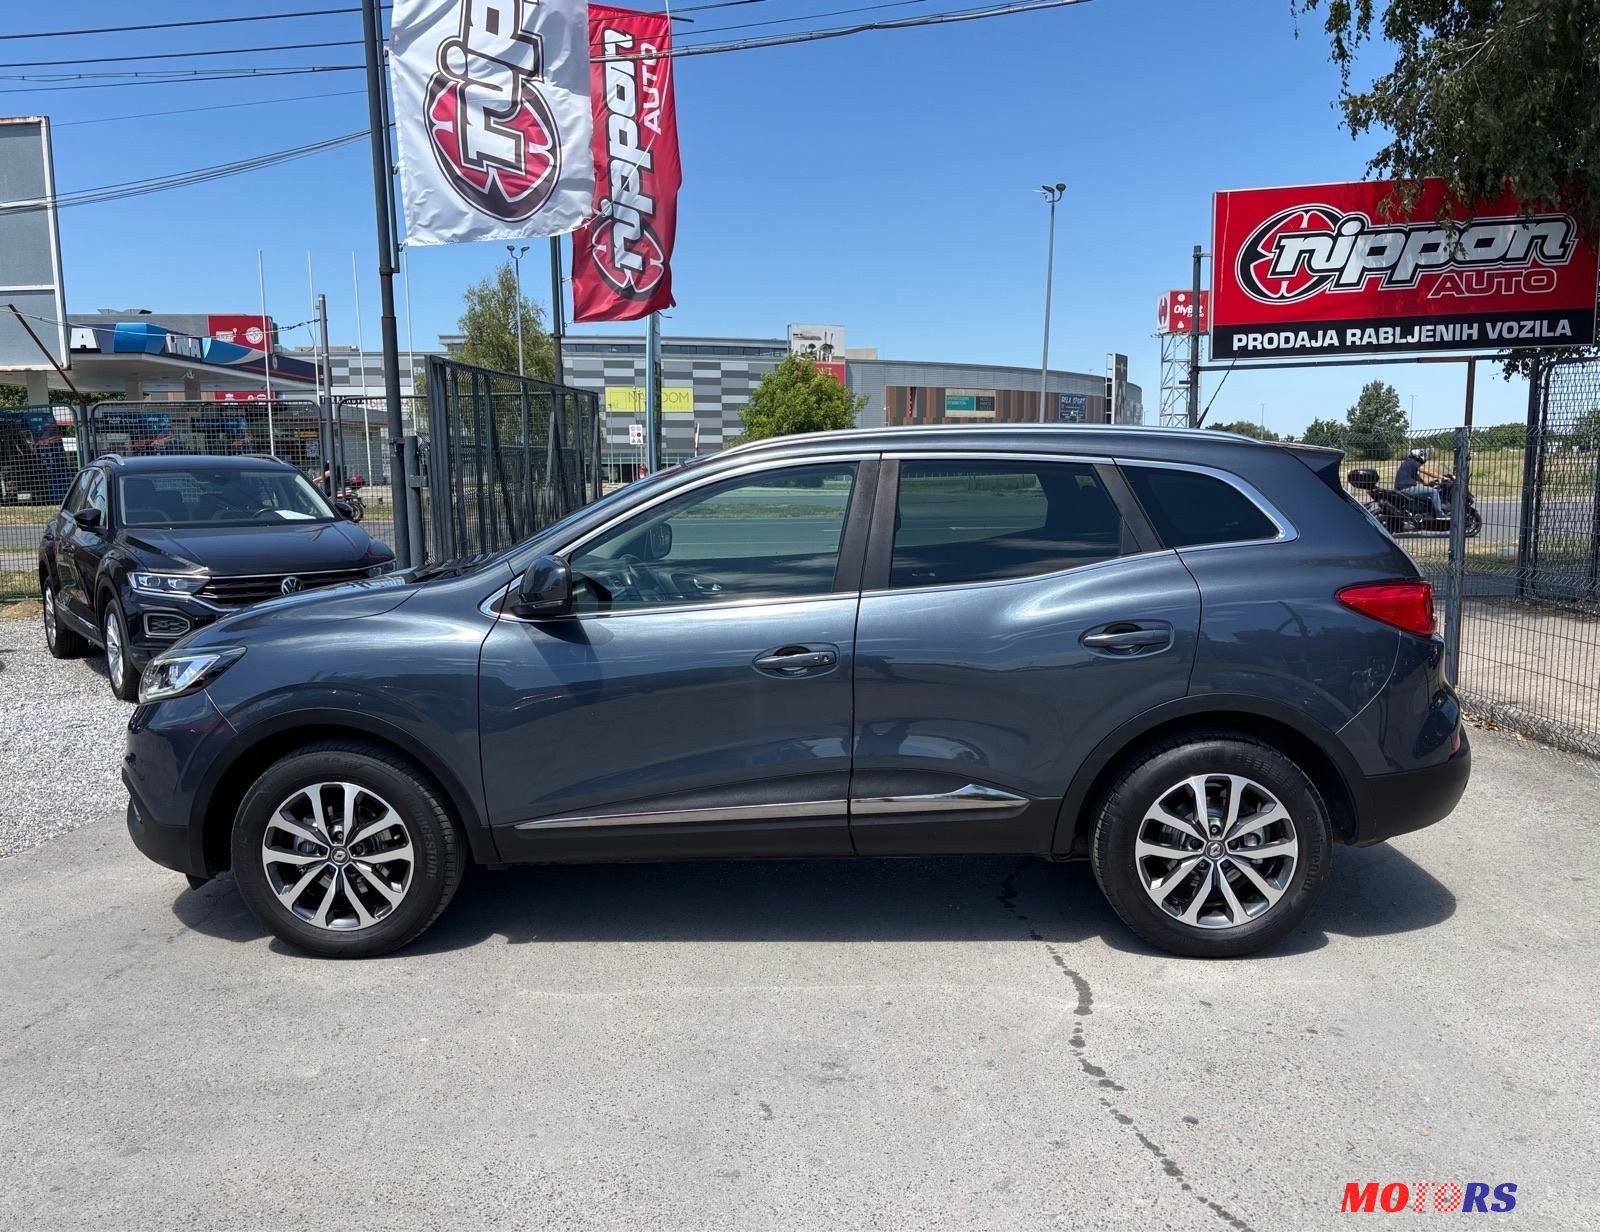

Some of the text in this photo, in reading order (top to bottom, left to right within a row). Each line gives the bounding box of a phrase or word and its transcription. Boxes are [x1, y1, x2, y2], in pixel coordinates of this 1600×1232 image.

[641, 42, 662, 135] AUTO
[1271, 214, 1573, 290] nippon
[1428, 268, 1558, 299] AUTO
[1174, 305, 1204, 316] OlyBt
[1232, 319, 1572, 351] PRODAJA RABLJENIH VOZILA
